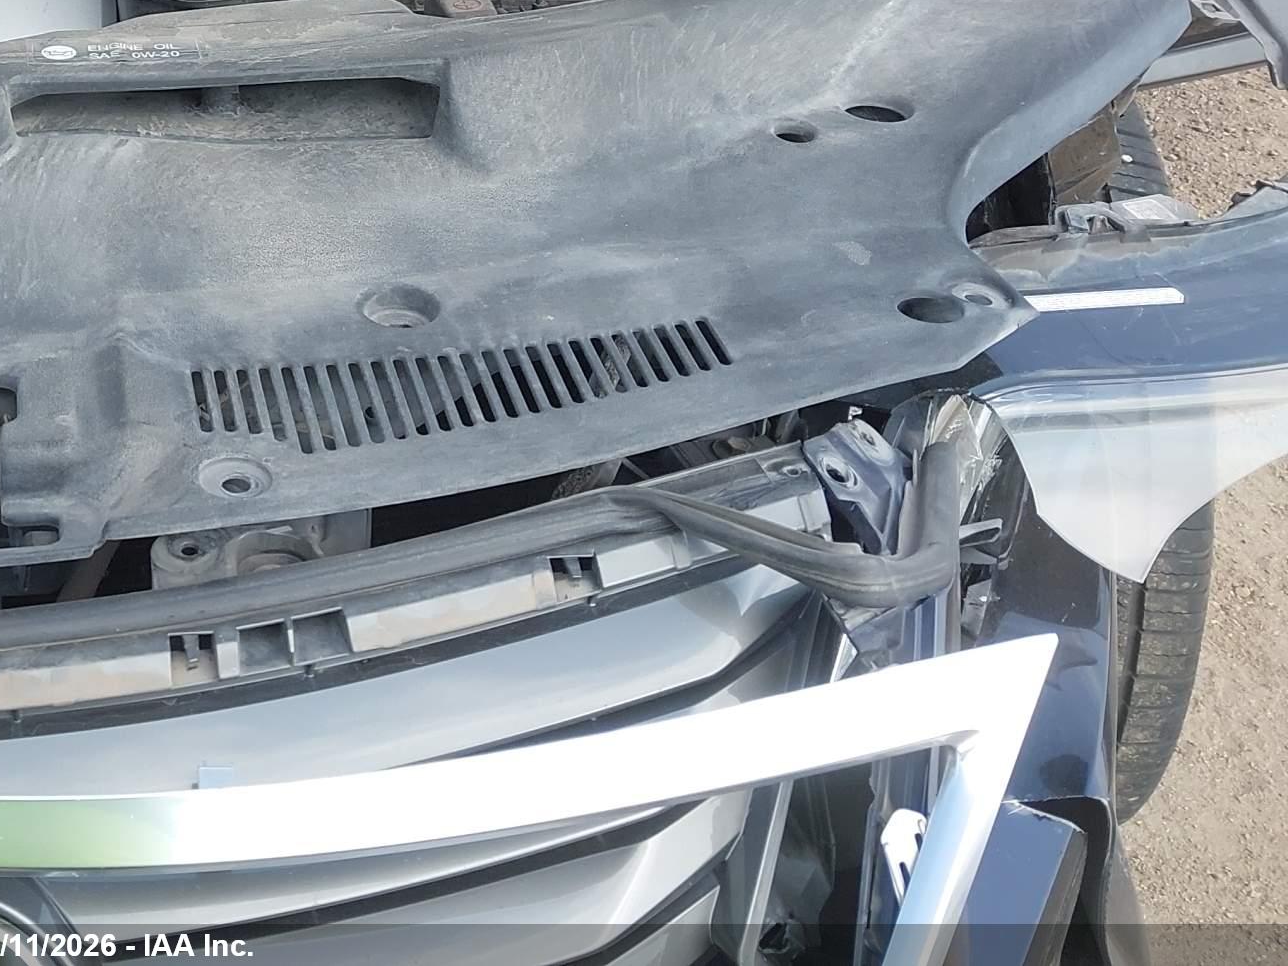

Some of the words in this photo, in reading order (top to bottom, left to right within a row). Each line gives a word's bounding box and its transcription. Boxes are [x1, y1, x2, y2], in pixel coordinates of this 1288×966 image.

[87, 42, 144, 52] ENGINE
[153, 42, 180, 51] OIL
[89, 51, 121, 60] SAE
[131, 50, 181, 59] 0W-20
